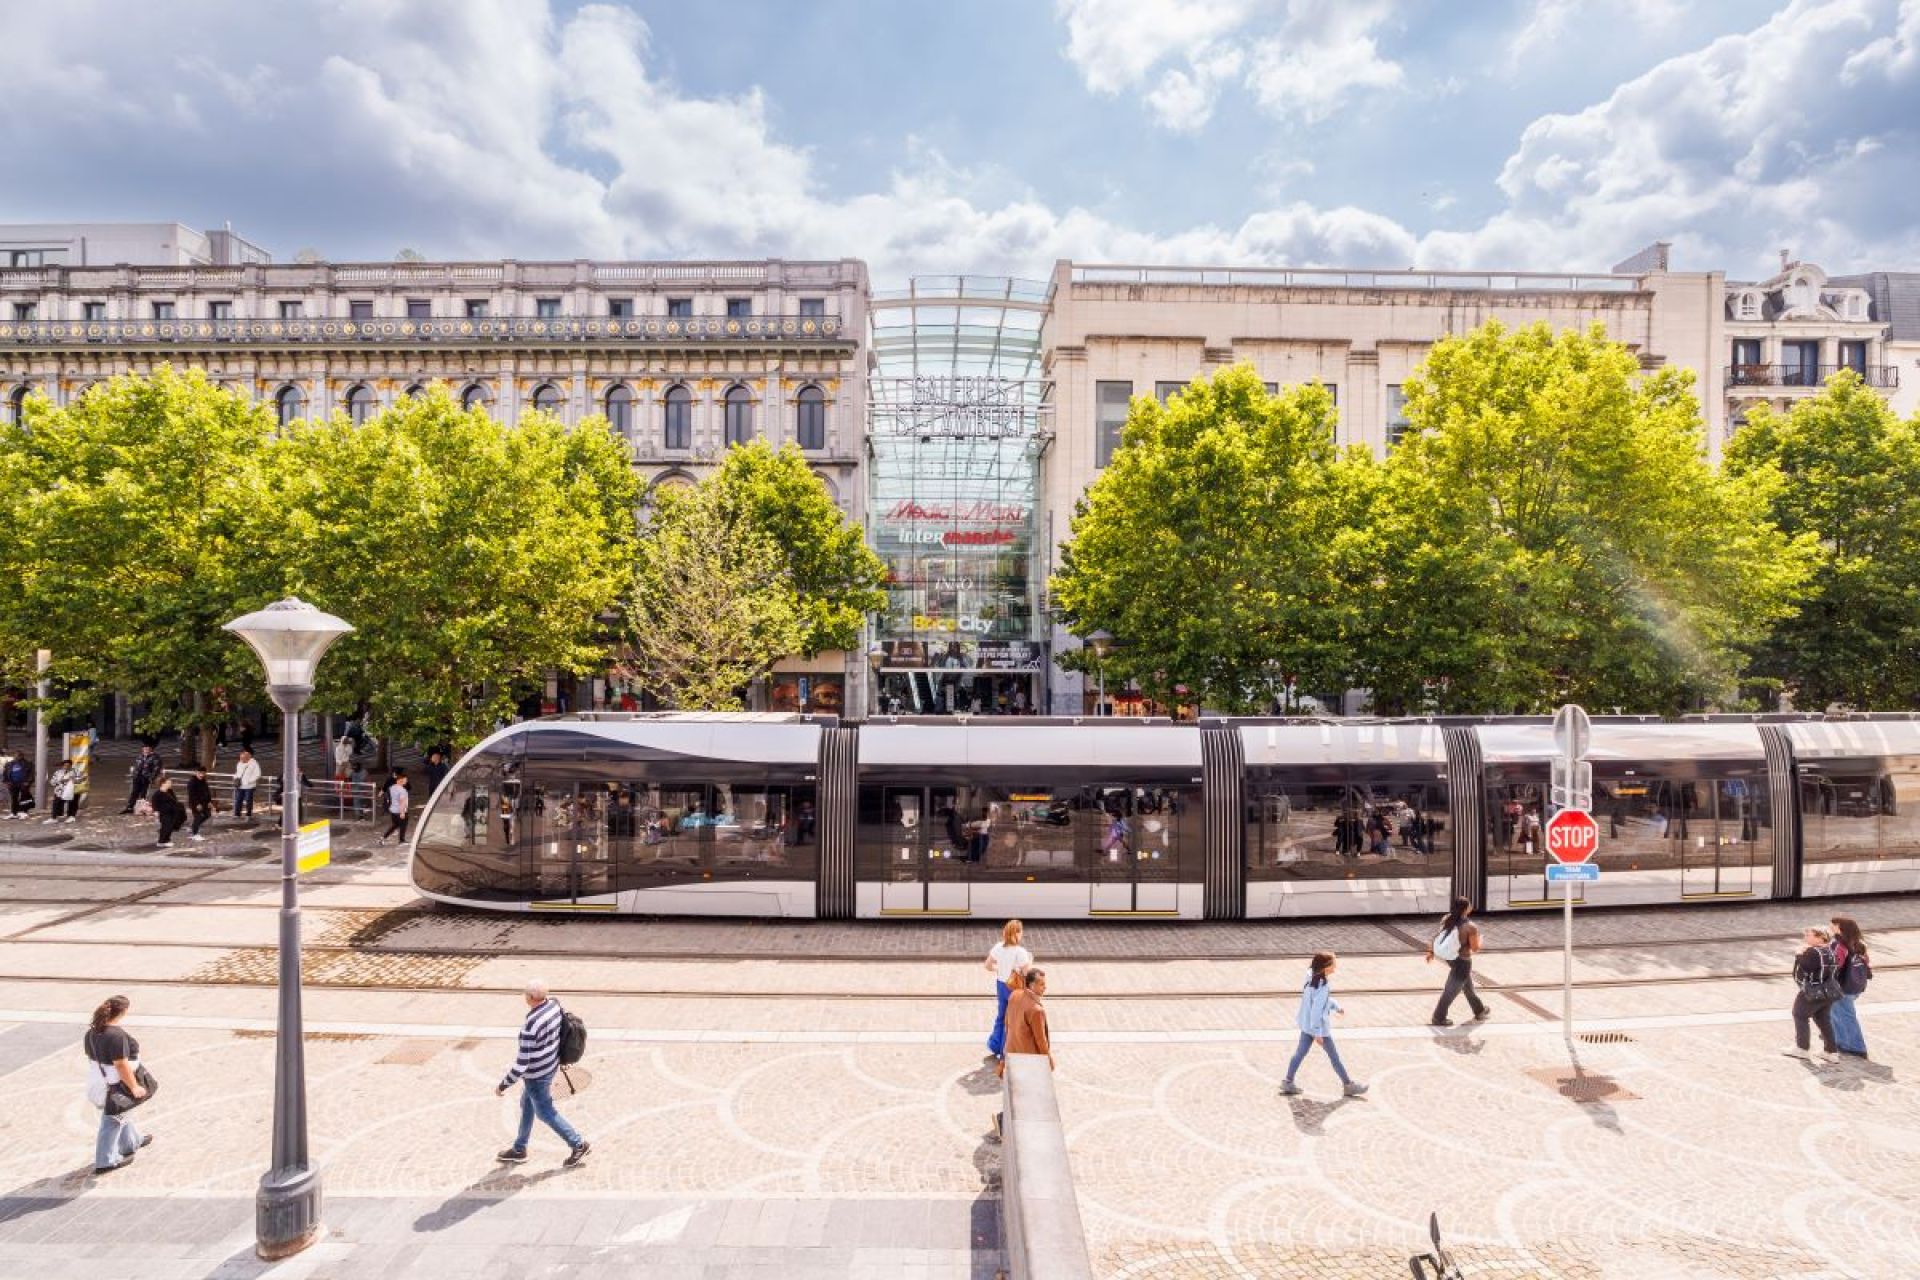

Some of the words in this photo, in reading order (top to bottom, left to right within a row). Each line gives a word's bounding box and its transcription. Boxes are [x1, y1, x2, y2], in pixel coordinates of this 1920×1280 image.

[913, 375, 1008, 405] GALERIES
[931, 406, 1023, 436] LAMBERT
[1551, 826, 1594, 849] STOP
